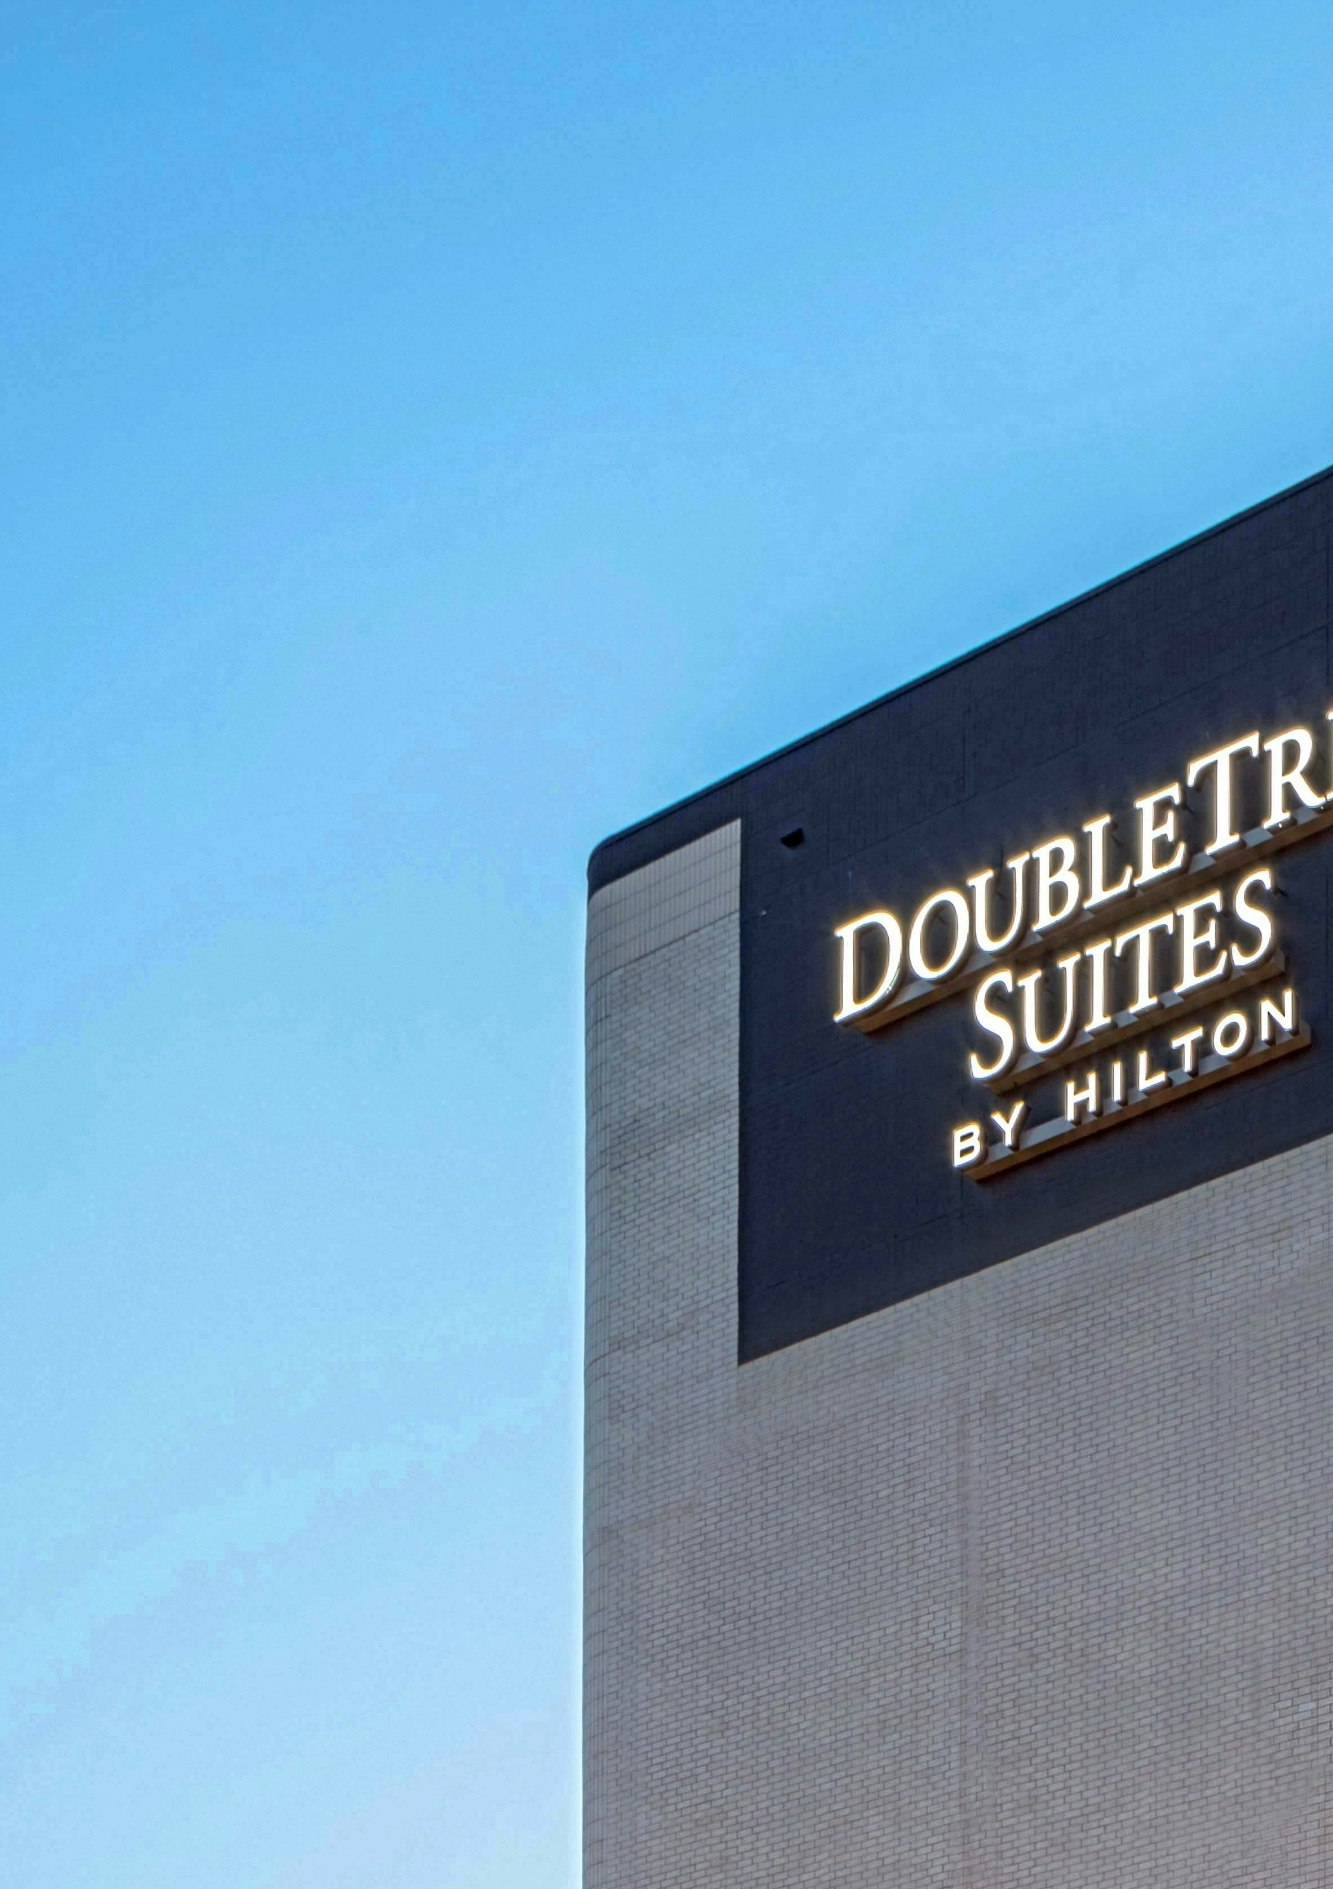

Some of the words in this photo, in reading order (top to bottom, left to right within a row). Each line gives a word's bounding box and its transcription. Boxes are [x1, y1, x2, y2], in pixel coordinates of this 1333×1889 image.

[970, 868, 1275, 1081] SUITES
[952, 1100, 1027, 1168] BY
[1065, 989, 1296, 1123] HILTON
